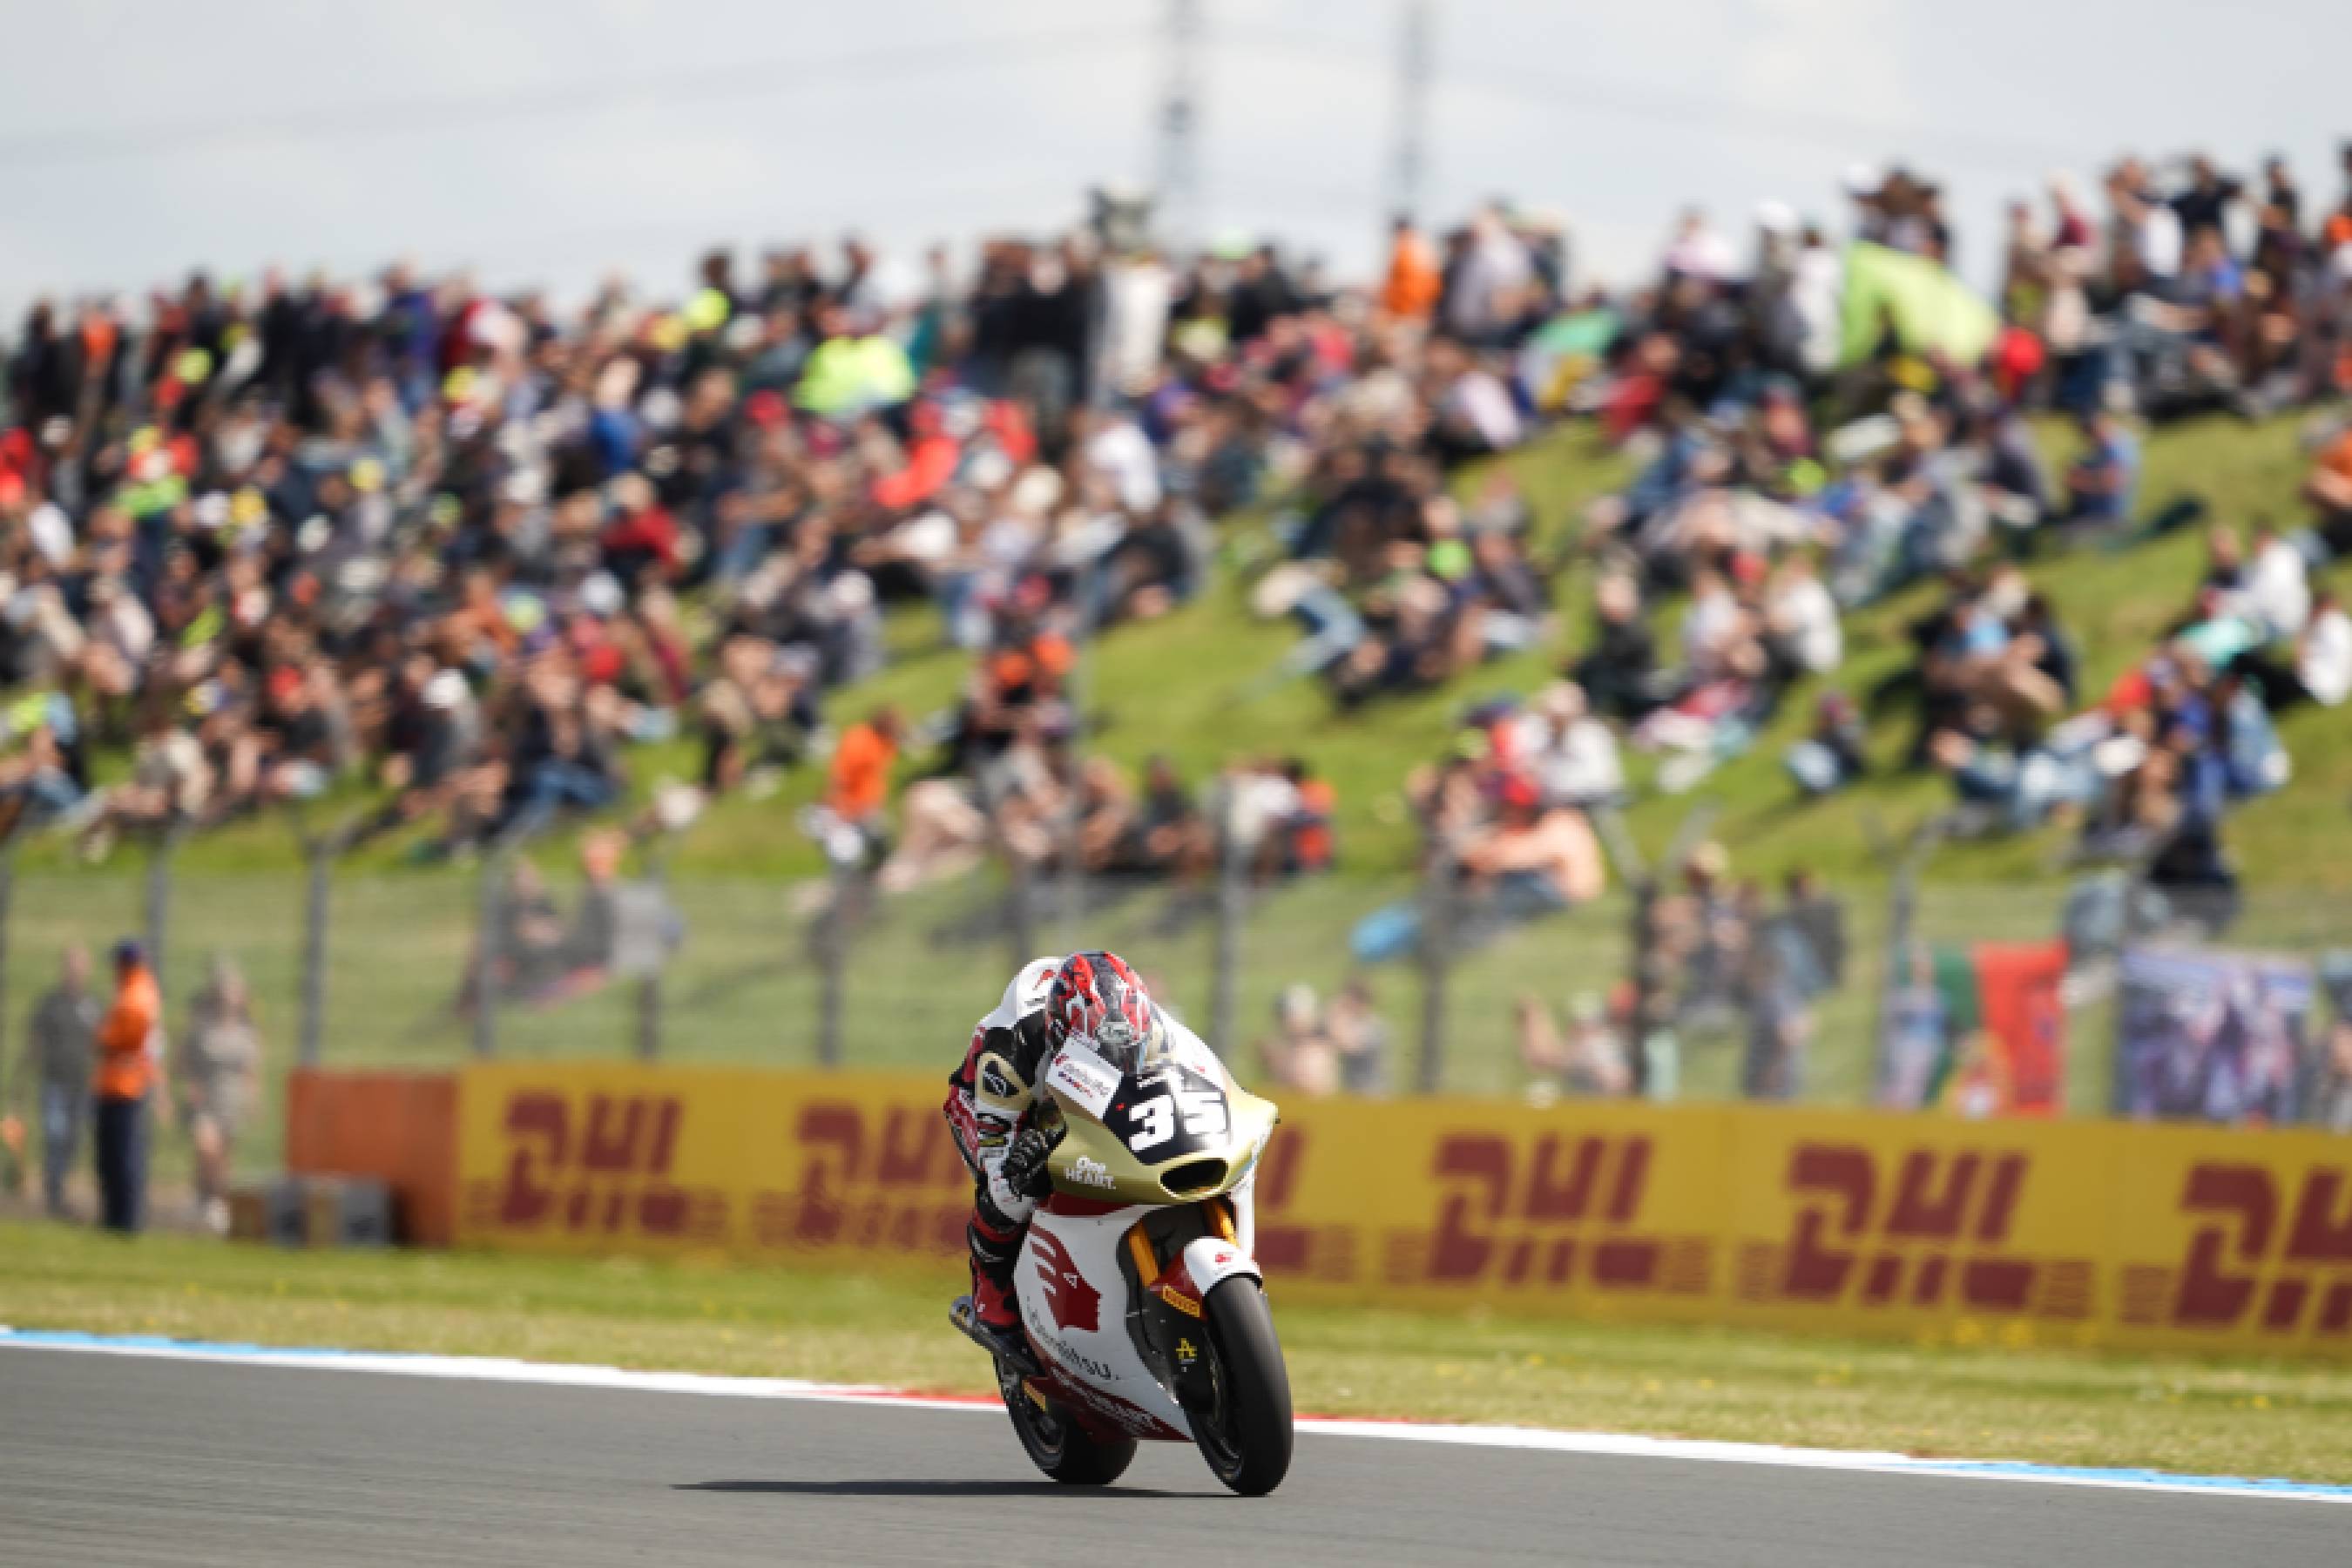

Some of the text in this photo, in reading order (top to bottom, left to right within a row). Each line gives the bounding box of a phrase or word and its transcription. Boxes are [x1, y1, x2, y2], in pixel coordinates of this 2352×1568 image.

[499, 1092, 692, 1235] DHL
[1128, 1089, 1231, 1153] 35
[1427, 1132, 1658, 1284] DHL
[1781, 1145, 2037, 1313] DHL
[2173, 1162, 2352, 1331] DH
